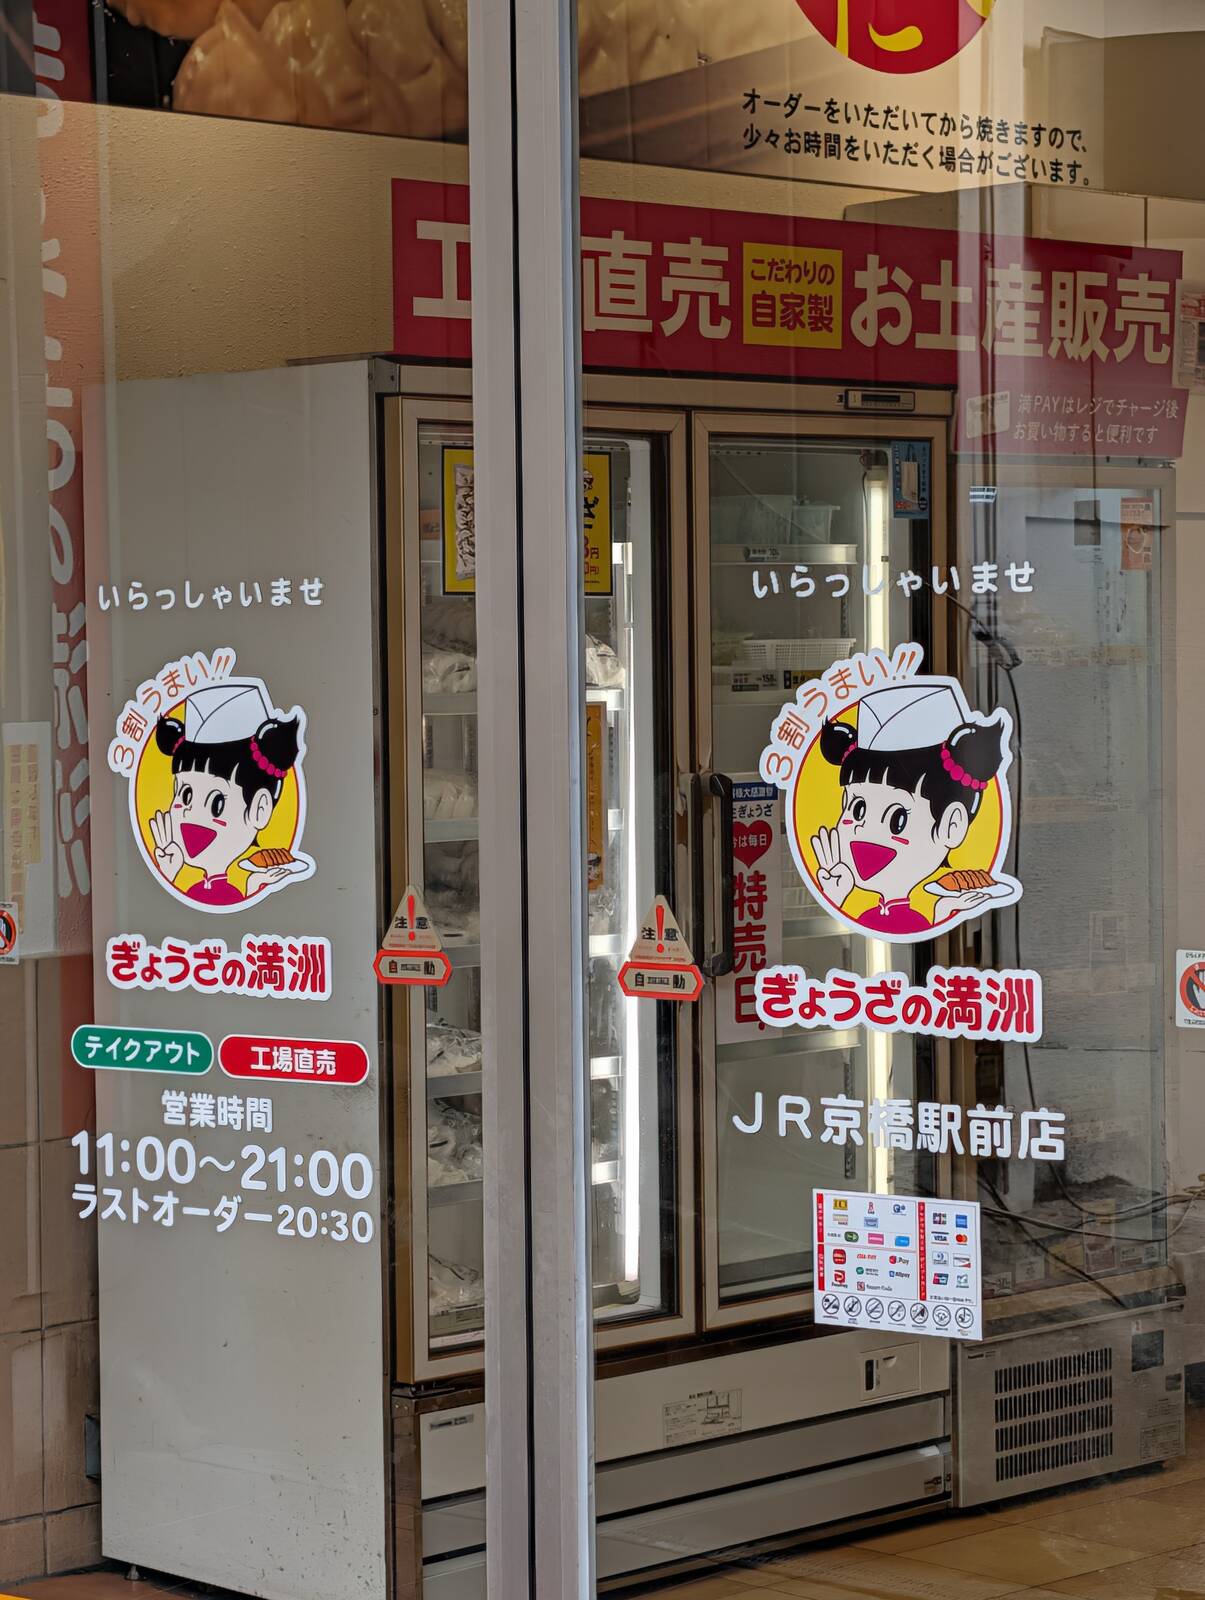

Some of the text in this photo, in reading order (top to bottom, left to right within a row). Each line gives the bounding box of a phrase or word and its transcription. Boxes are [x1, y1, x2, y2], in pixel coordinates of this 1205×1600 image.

[742, 88, 1087, 153] オーダーをいただいてから焼きますので、
[743, 123, 1090, 186] 少々お時間をいただく場合がございます。
[750, 258, 835, 287] こだわりの
[751, 289, 834, 334] 自家製
[850, 254, 1172, 365] お土産販売
[98, 577, 324, 611] いらっしゃいませ
[752, 561, 1036, 599] いらっしゃいませ
[110, 940, 327, 994] ぎょうざの満洲
[760, 972, 1036, 1035] ぎょうざの満洲
[84, 1035, 201, 1066] テイクアウト
[250, 1046, 337, 1076] 工場直売
[161, 1089, 273, 1134] 営業時間
[731, 1090, 1067, 1162] JR京橋駅前店
